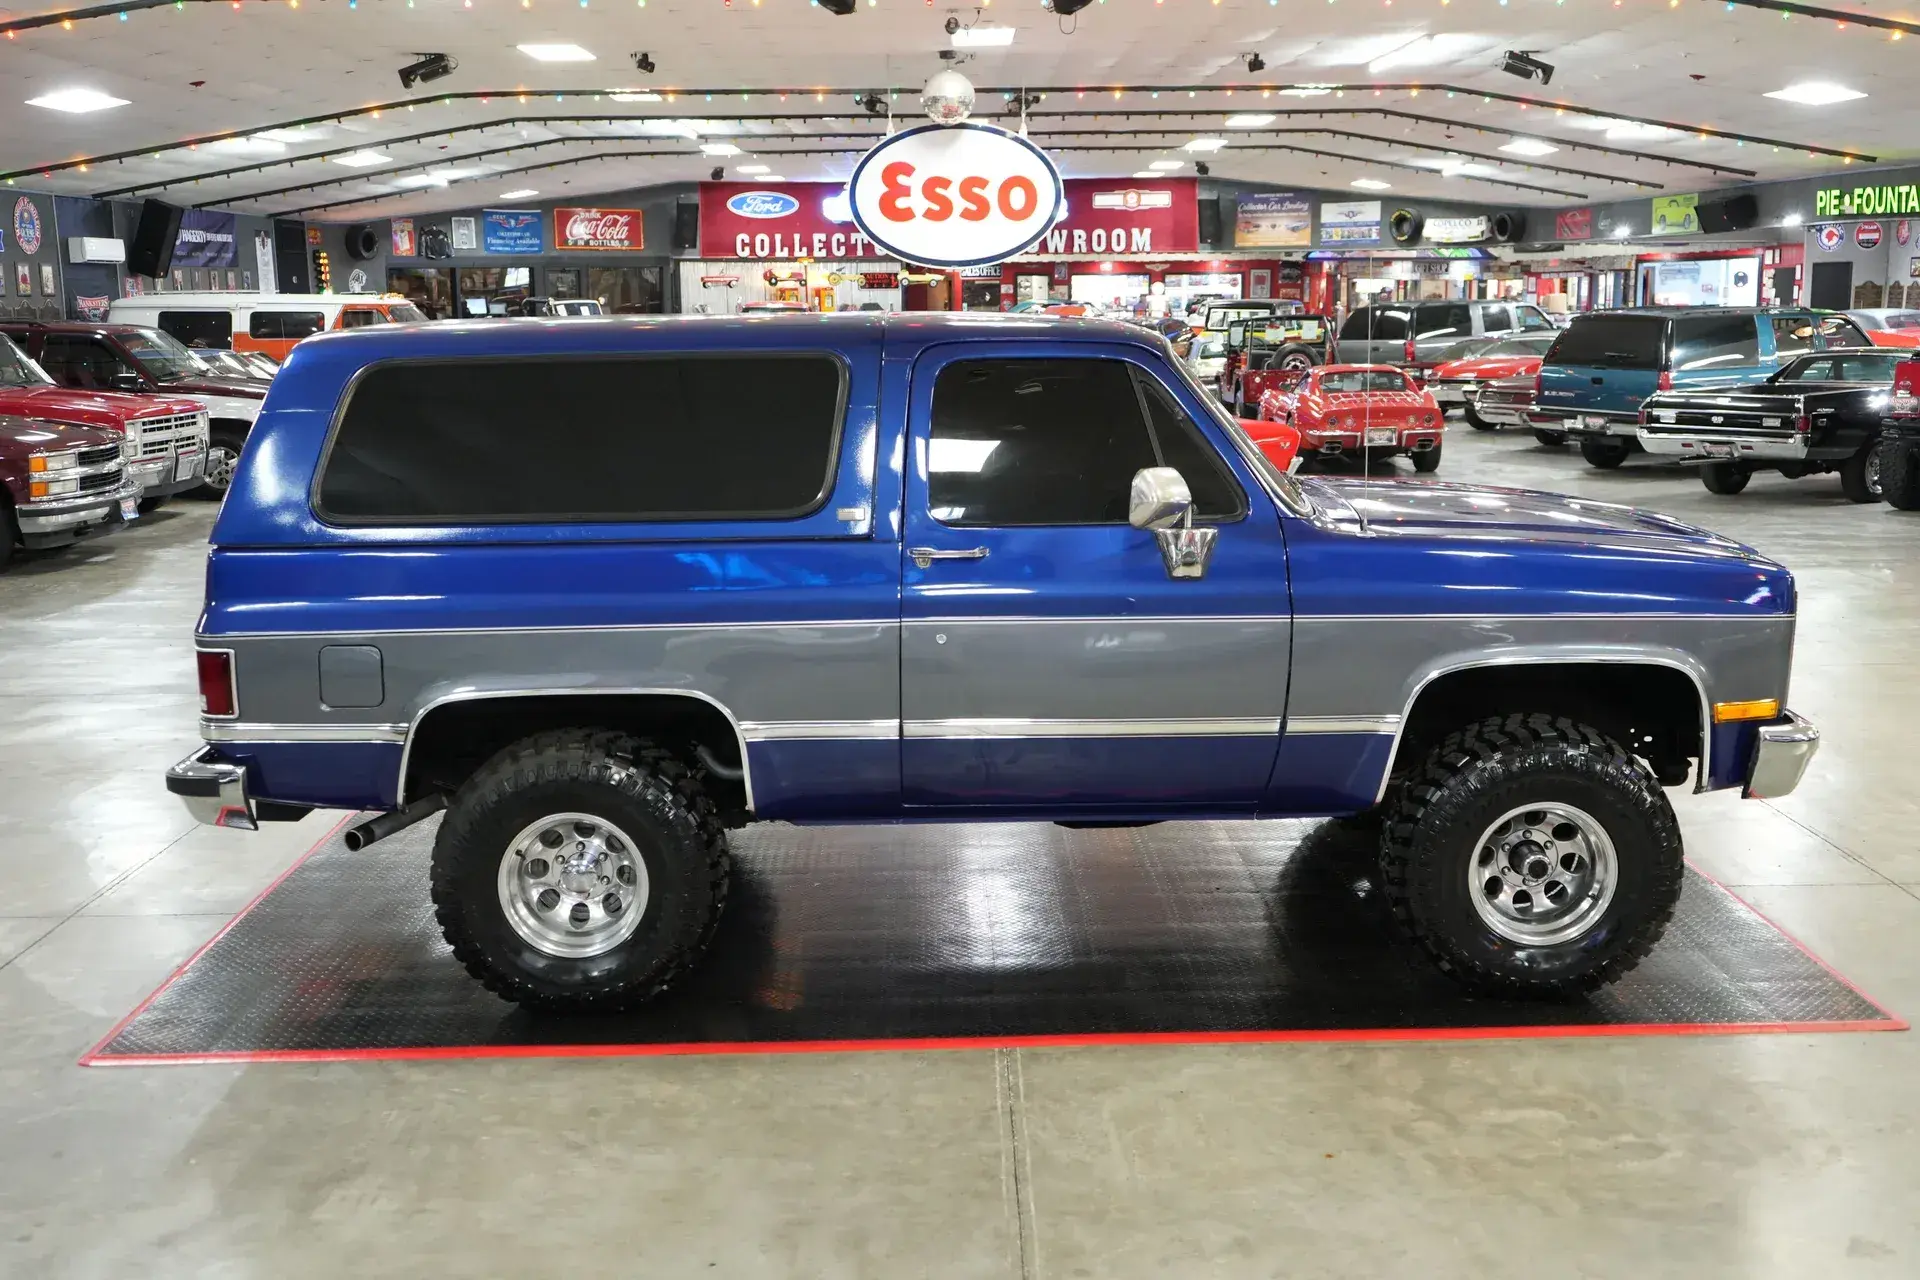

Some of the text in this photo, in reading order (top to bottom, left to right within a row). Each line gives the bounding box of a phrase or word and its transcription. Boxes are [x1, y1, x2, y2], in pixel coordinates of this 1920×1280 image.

[742, 195, 783, 214] Ford
[1816, 185, 1920, 216] PIE FOUNTA
[565, 214, 632, 240] Coca-Cola
[1026, 228, 1152, 254] WROOM
